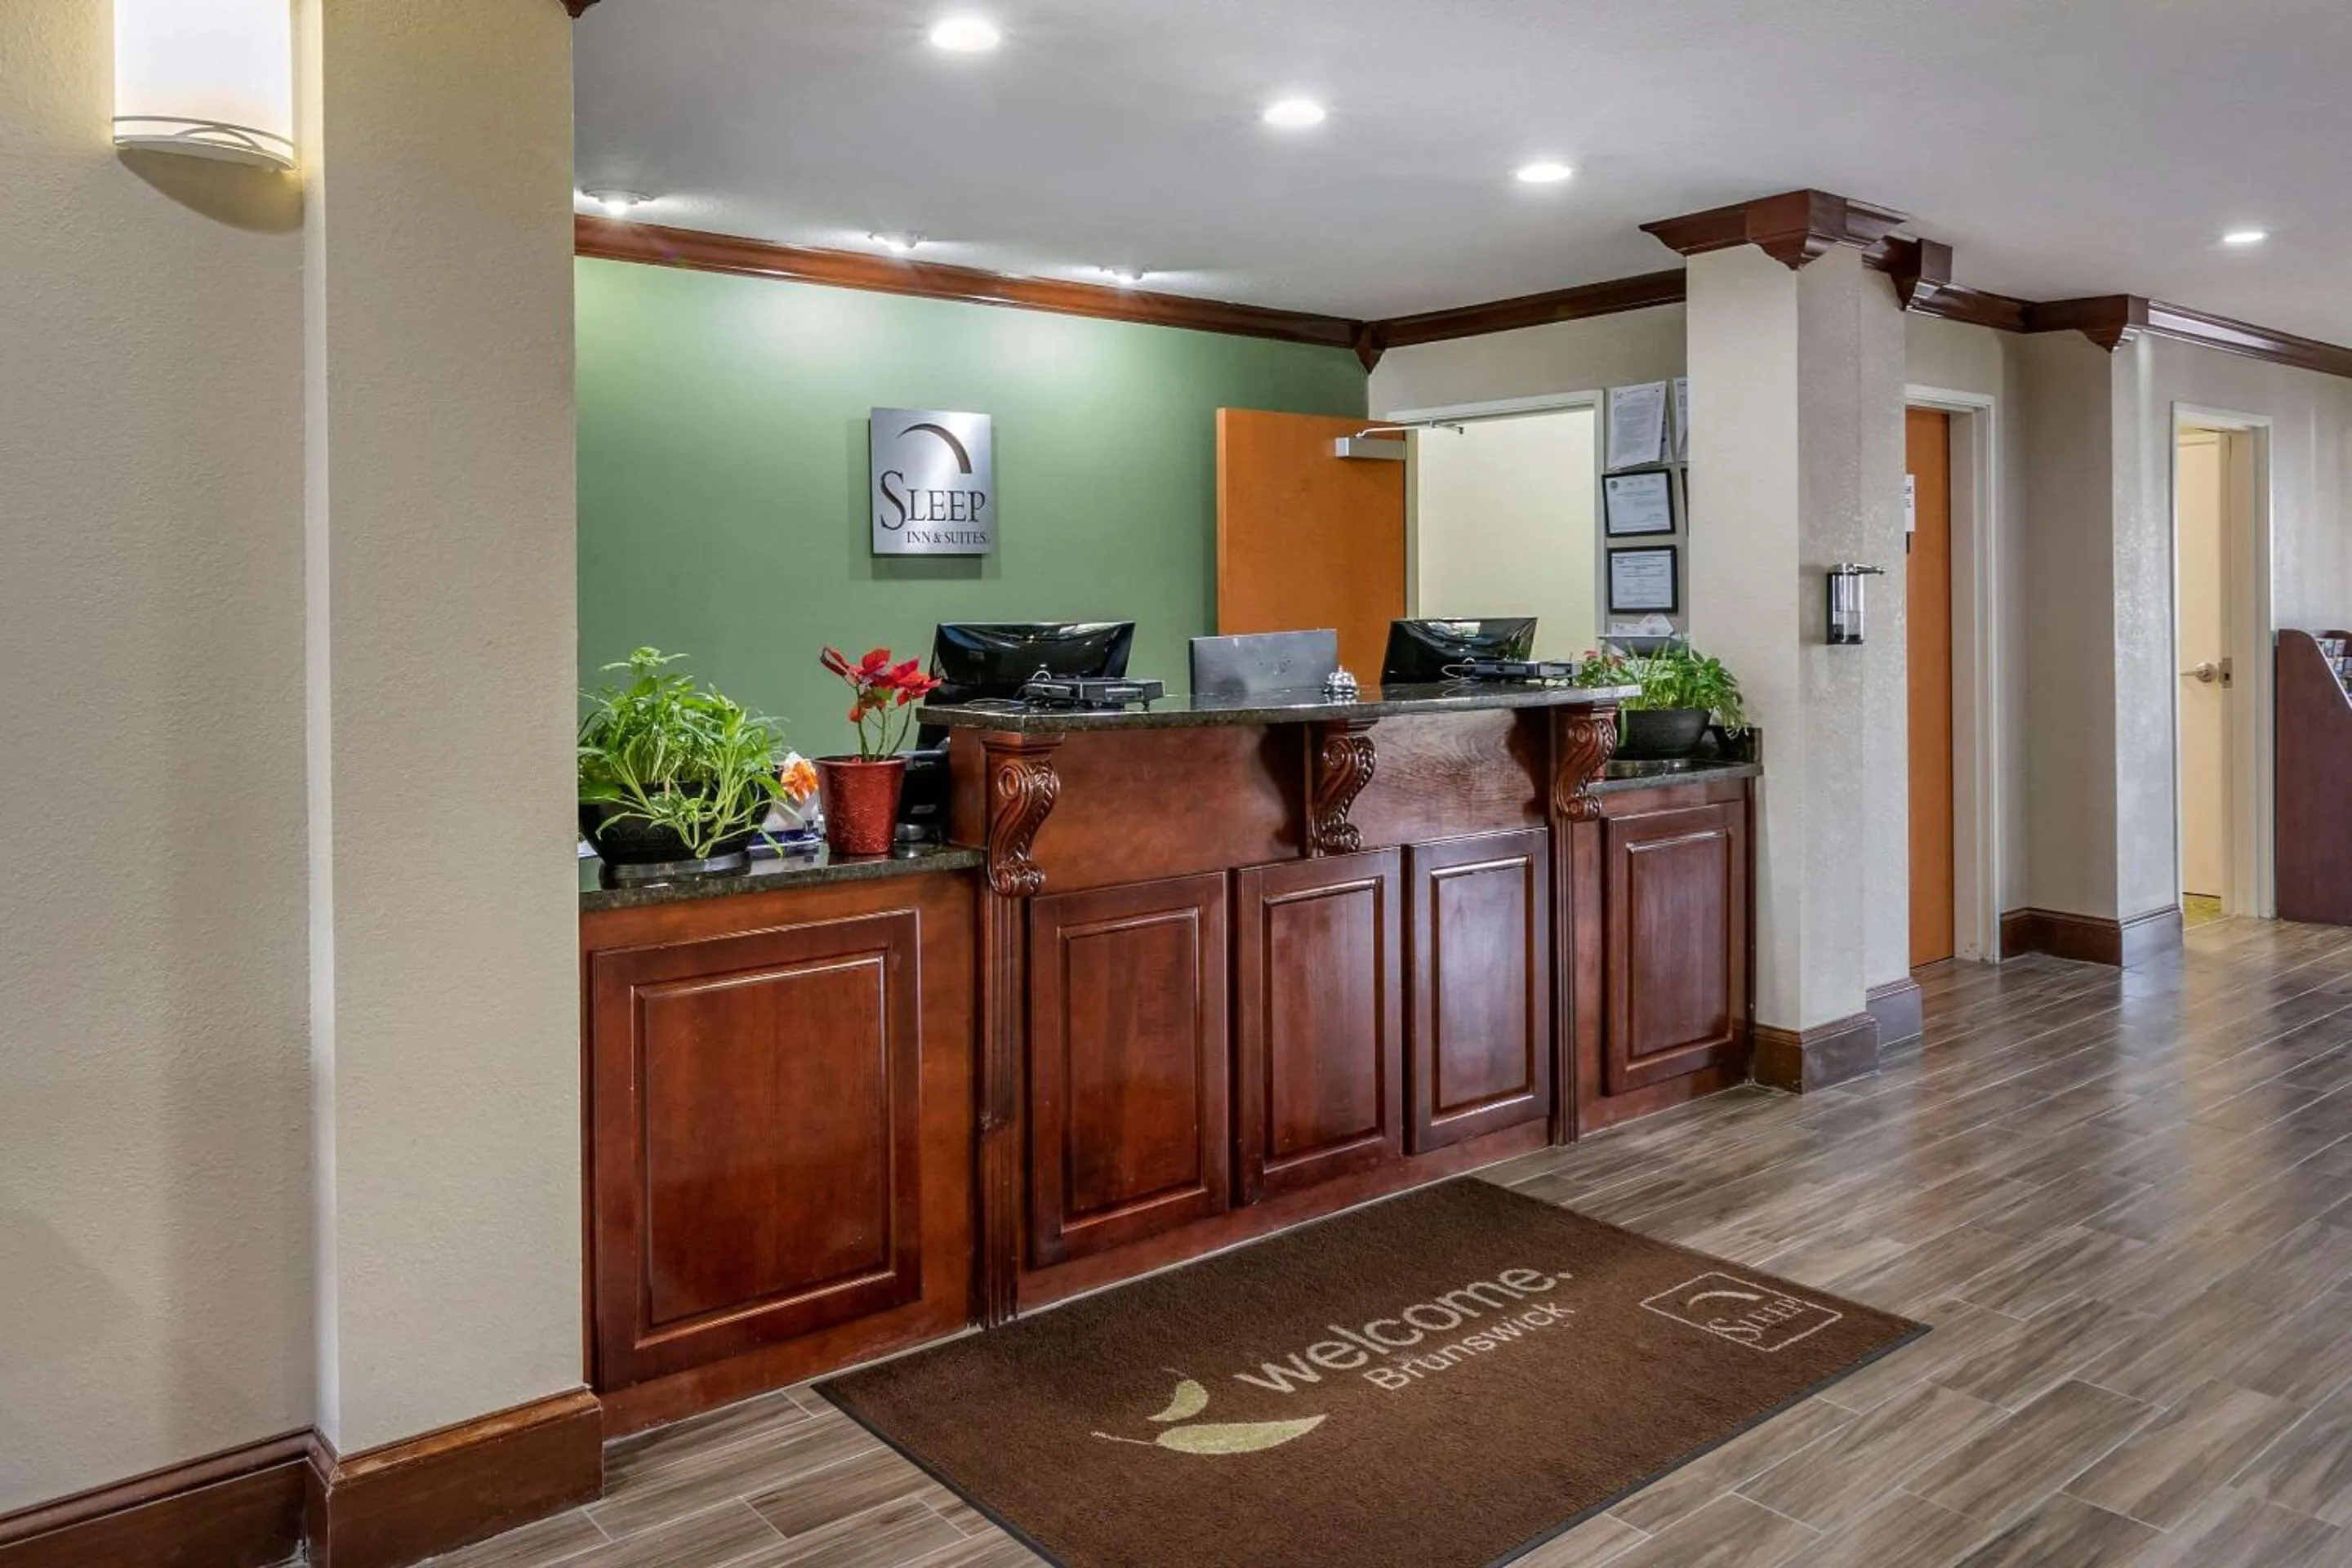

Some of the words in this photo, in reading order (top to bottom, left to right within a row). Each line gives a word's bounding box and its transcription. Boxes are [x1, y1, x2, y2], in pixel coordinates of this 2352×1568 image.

[880, 470, 986, 530] SLEEP
[907, 531, 931, 544] INN
[933, 531, 942, 544] &
[944, 531, 987, 545] SUITES
[1232, 1268, 1573, 1393] welcome.
[1362, 1303, 1575, 1390] Brunswick
[1708, 1298, 1804, 1342] SLEEP
